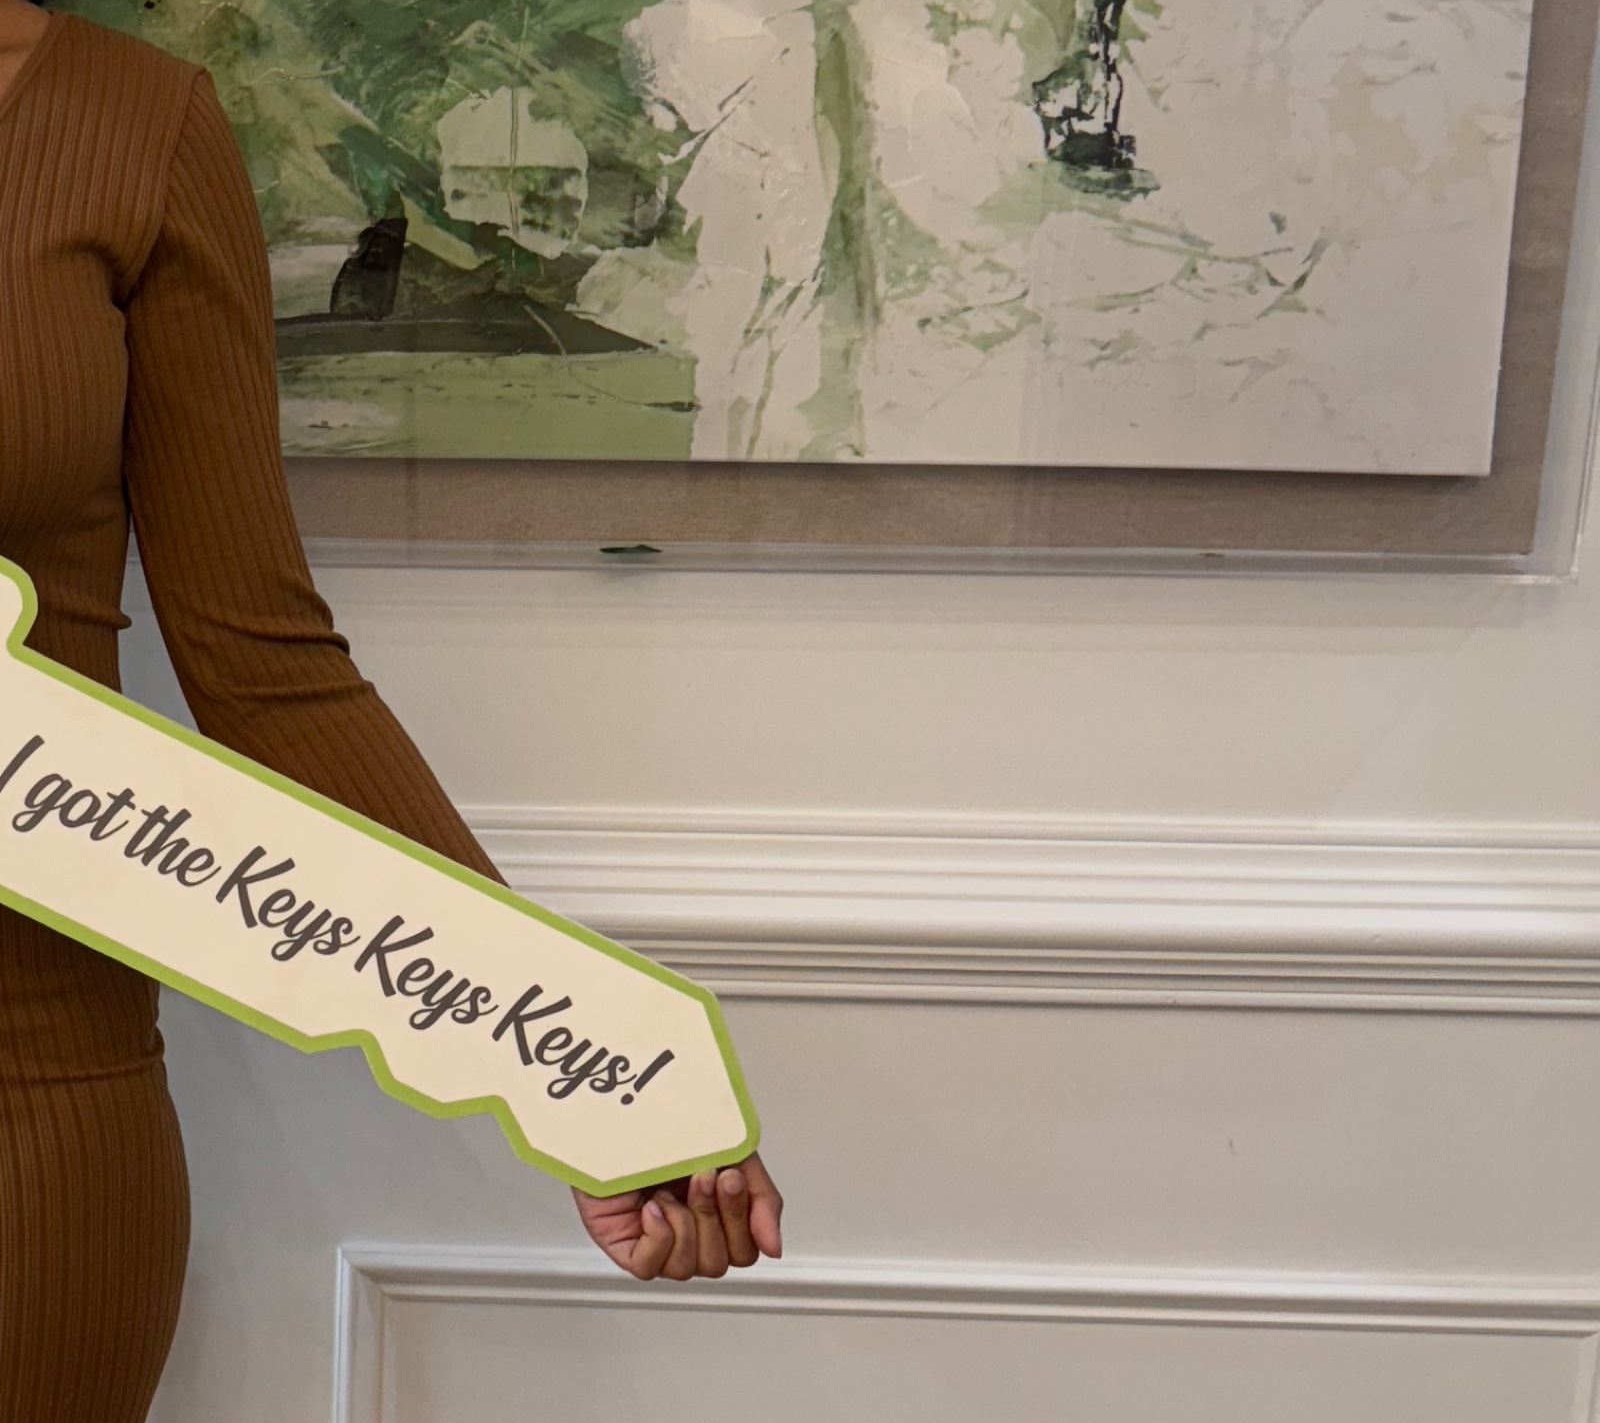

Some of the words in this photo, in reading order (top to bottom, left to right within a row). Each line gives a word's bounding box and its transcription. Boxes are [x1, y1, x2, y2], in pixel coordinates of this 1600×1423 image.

[12, 774, 133, 841] got
[124, 805, 221, 887] the
[215, 845, 361, 962] Keys
[354, 915, 498, 1030] Keys
[492, 984, 675, 1106] Keys!
